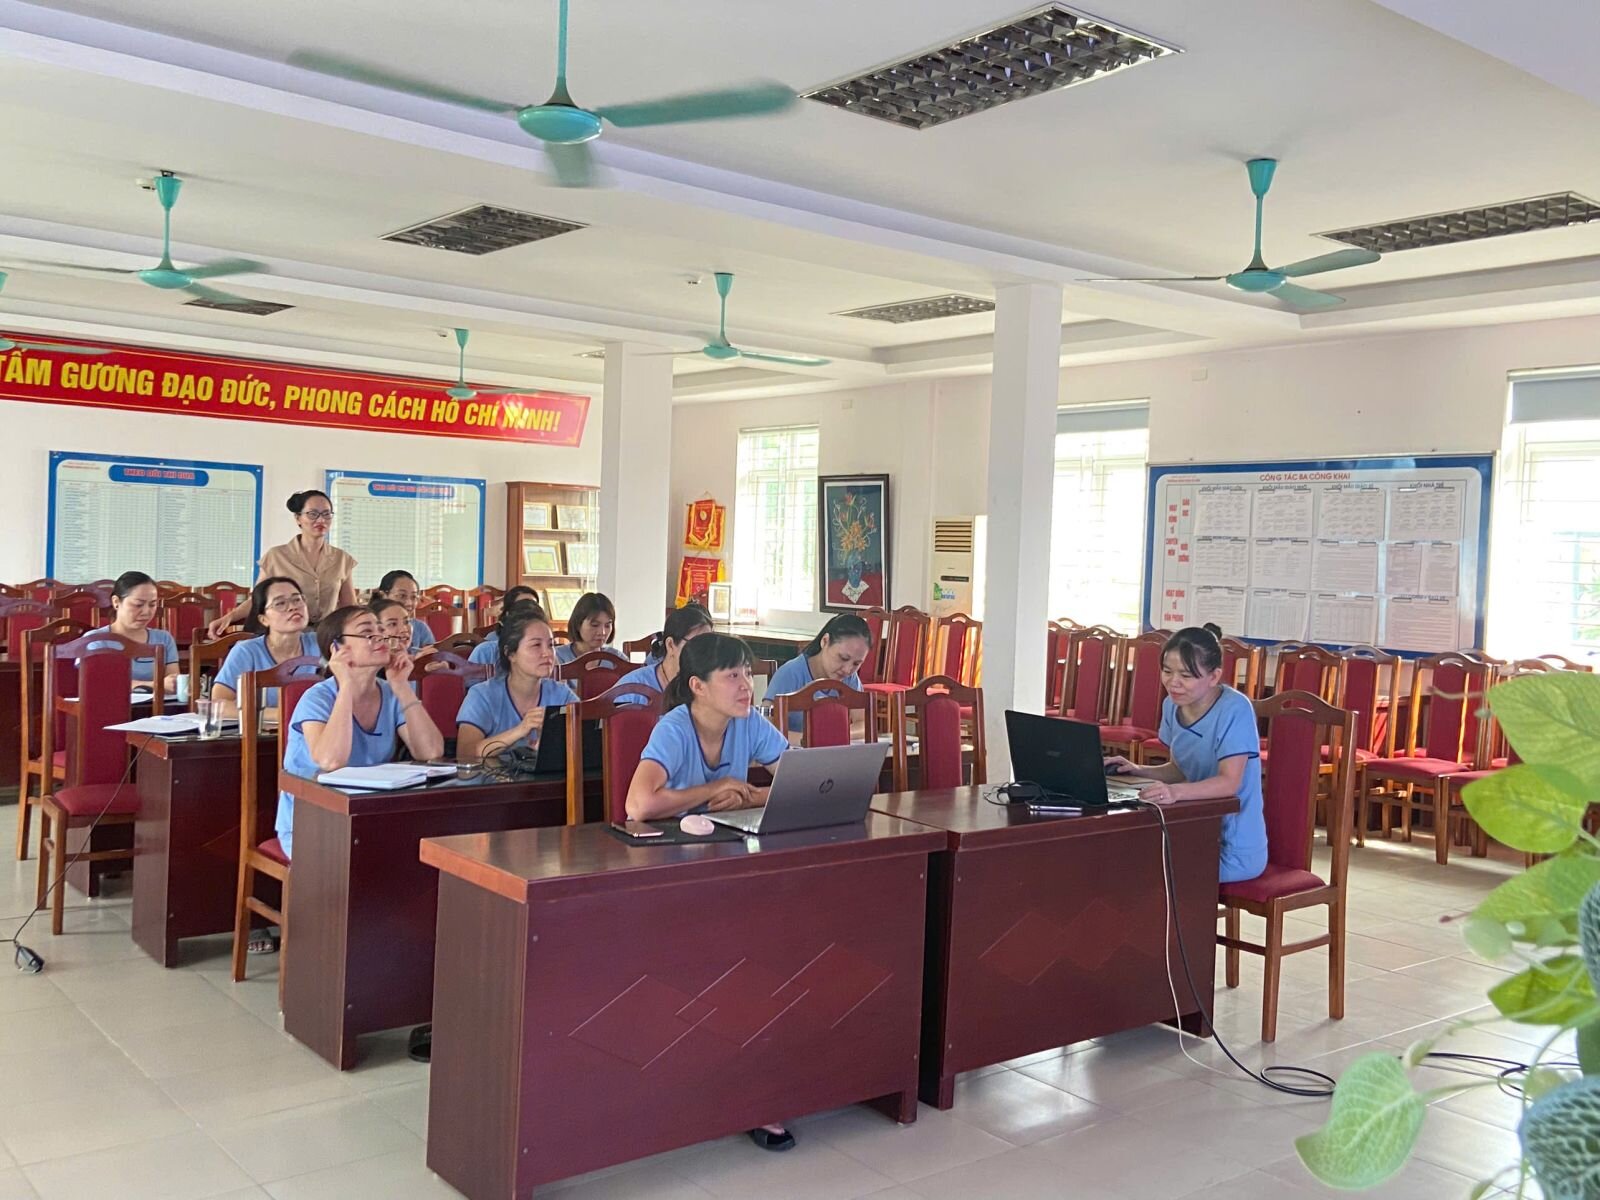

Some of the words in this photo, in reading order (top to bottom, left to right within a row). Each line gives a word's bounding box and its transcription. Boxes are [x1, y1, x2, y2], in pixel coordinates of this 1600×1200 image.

[60, 361, 155, 396] GƯƠNG
[161, 372, 214, 405] ĐẠO
[220, 374, 276, 410] ĐỨC,
[283, 384, 363, 416] PHONG
[368, 391, 425, 421] CÁCH
[464, 400, 500, 427] CHÍ
[1309, 471, 1332, 480] CÔNG
